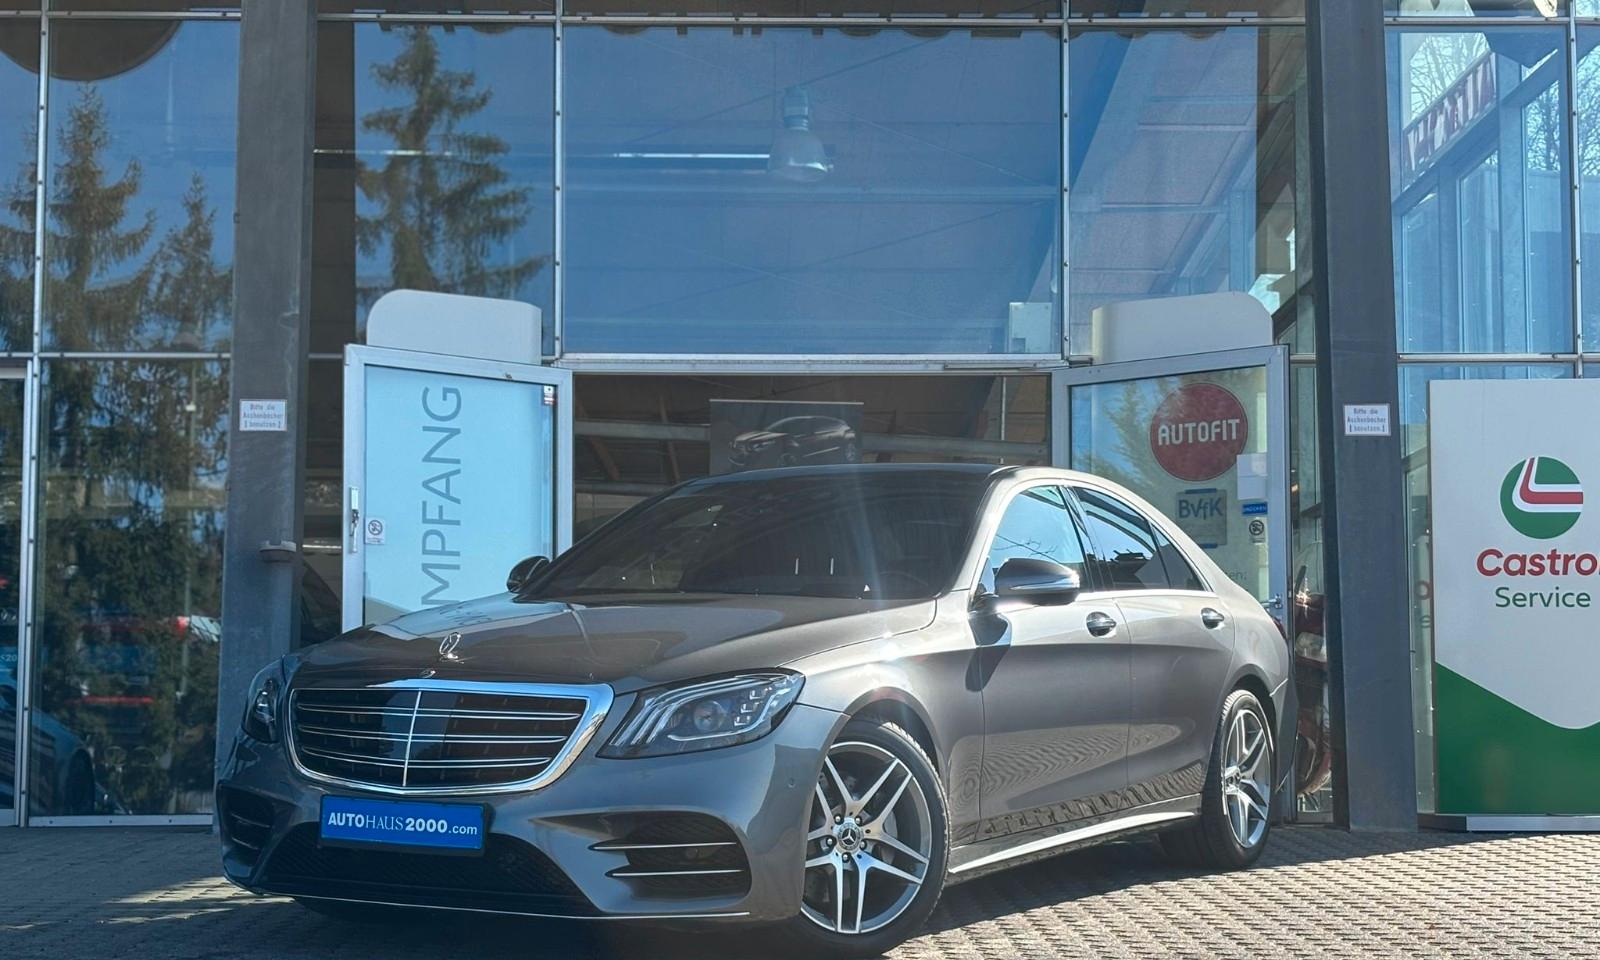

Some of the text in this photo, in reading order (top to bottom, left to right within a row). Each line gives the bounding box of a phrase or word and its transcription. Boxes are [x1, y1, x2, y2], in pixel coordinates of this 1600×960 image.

[1157, 418, 1241, 446] AUTOFIT
[421, 386, 462, 606] MPFANG
[1476, 548, 1600, 577] Castro
[1495, 586, 1591, 608] Service
